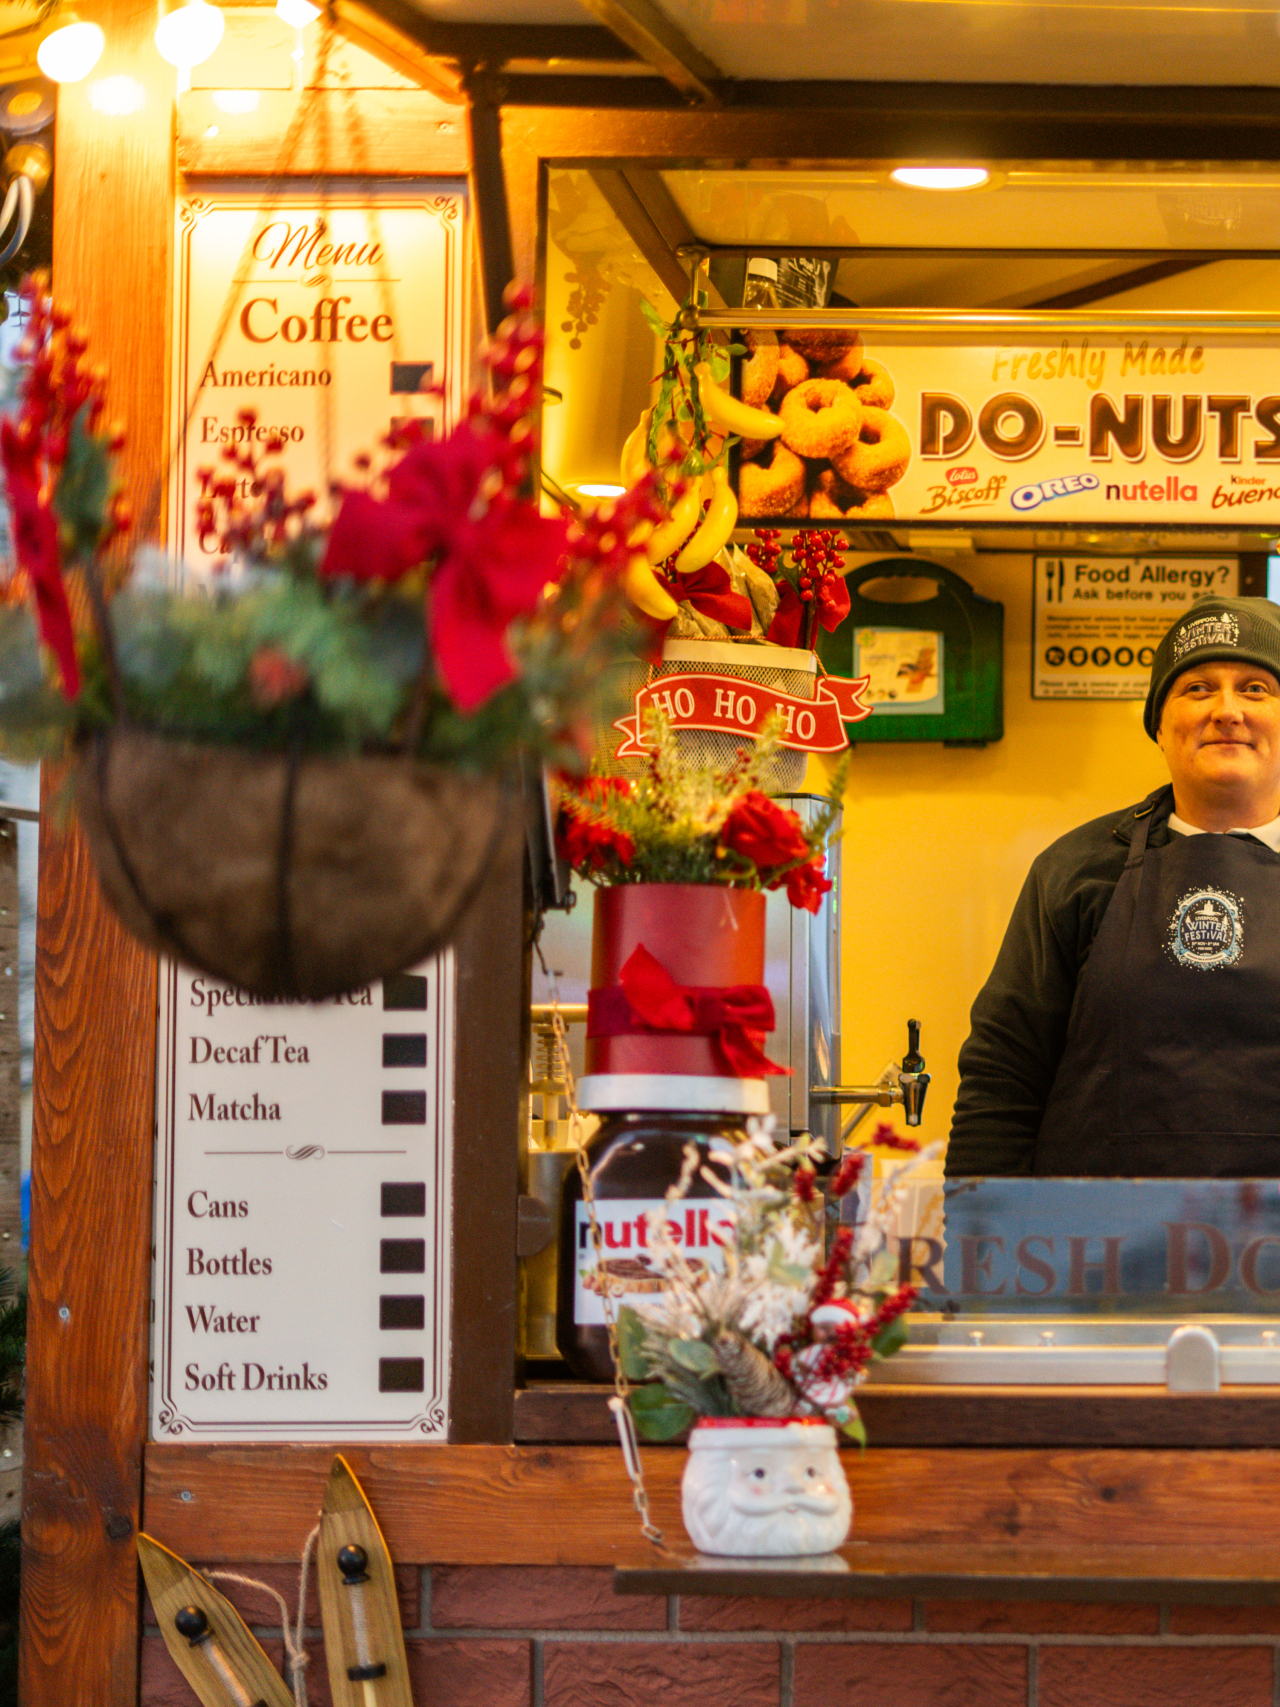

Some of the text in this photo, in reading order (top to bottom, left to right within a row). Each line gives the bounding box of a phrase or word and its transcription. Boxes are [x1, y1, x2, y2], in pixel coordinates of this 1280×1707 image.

[252, 221, 383, 269] Menu
[240, 296, 394, 343] Coffee
[200, 361, 332, 388] Americano
[991, 338, 1205, 389] Freshly Made
[200, 416, 305, 447] Espresso
[919, 475, 1007, 514] Biscoff
[1011, 474, 1099, 510] OREO
[1106, 476, 1198, 501] nutella
[1075, 565, 1229, 587] Food Allergy?
[1073, 587, 1099, 600] Ask
[1106, 587, 1153, 600] before
[1160, 590, 1186, 603] you
[1176, 621, 1233, 645] WINTER
[1177, 632, 1235, 658] FESTIVAL
[651, 687, 816, 741] HO HO HO
[1184, 930, 1228, 943] FESTIVAL
[1186, 921, 1228, 933] WINTER
[189, 1034, 310, 1064] Decaf Tea
[188, 1092, 282, 1121] Matcha
[187, 1190, 249, 1218] Cans
[186, 1247, 272, 1276] Bottles
[888, 1233, 1127, 1297] RESH
[185, 1305, 260, 1333] Water
[184, 1362, 329, 1391] Soft Drinks
